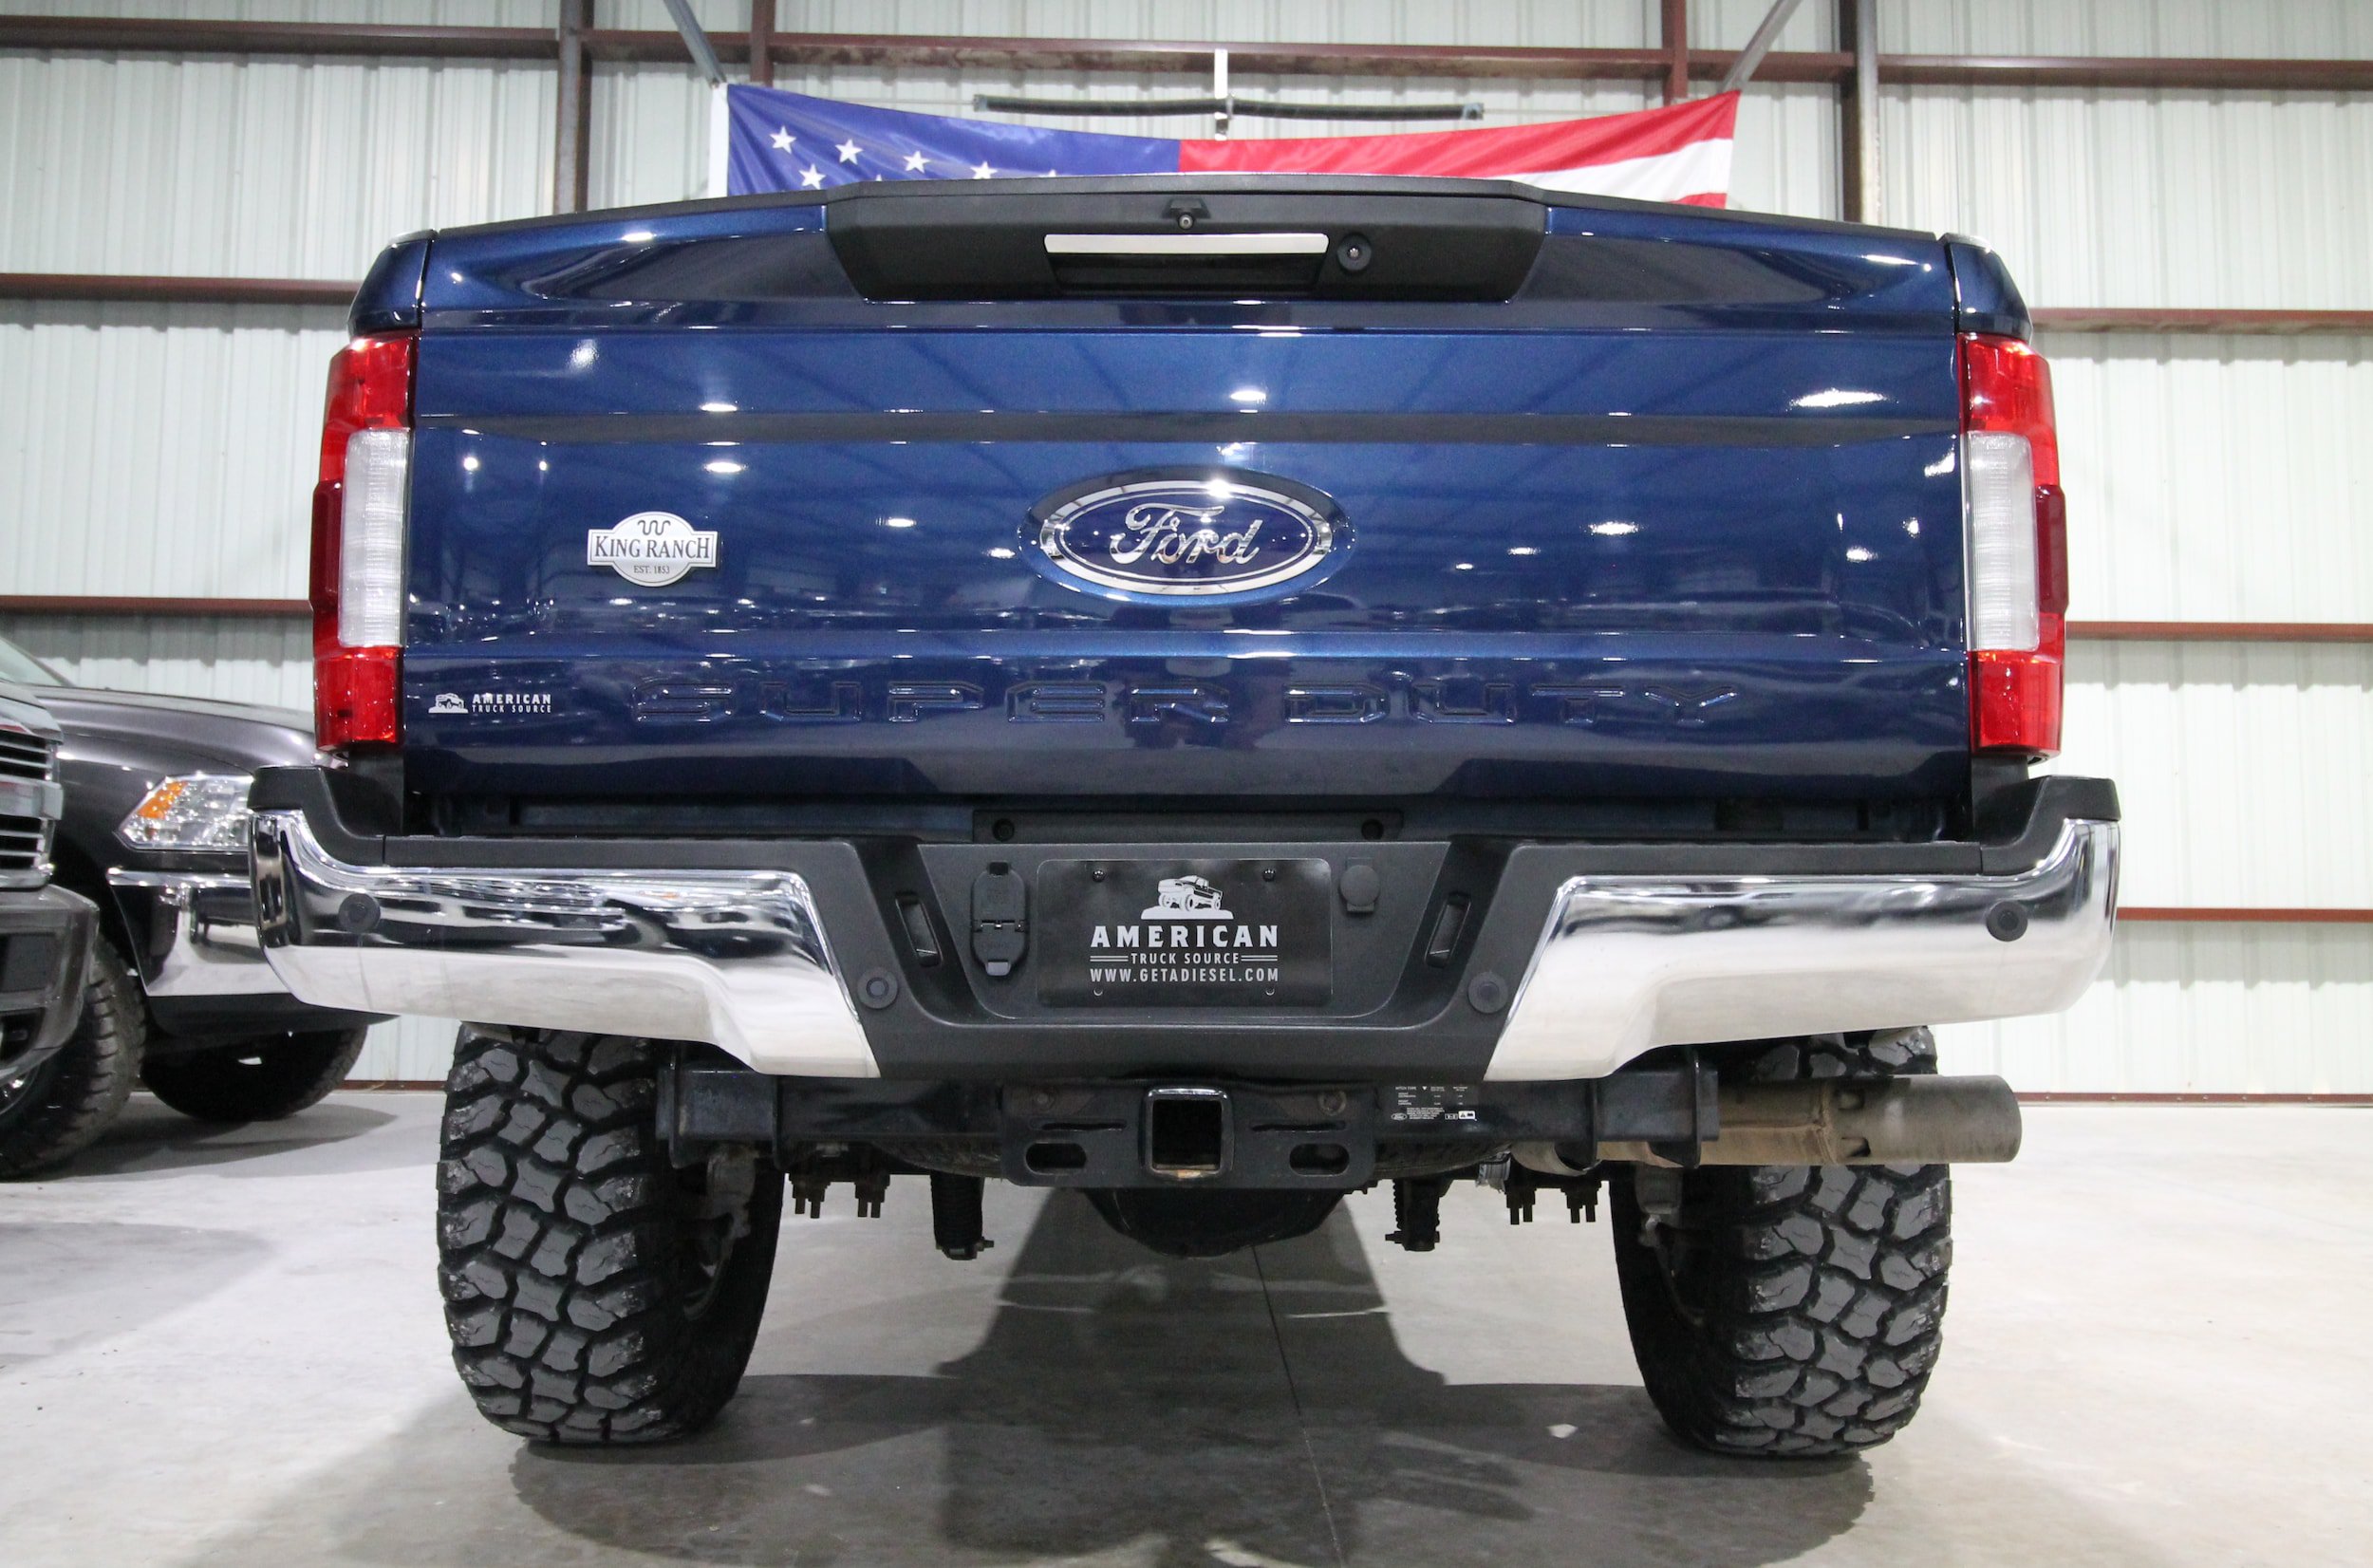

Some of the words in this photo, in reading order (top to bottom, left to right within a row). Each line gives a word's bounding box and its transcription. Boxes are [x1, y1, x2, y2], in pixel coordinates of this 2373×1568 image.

[1110, 502, 1262, 565] Ford
[594, 535, 641, 558] KING
[645, 537, 710, 559] RANCH
[633, 565, 652, 574] EST.
[654, 566, 670, 574] 1853
[472, 694, 551, 704] AMERICAN
[631, 680, 1229, 723] SUPER
[1283, 682, 1739, 724] DUTY
[472, 704, 505, 713] TRUCK
[1091, 924, 1278, 948] AMERICAN
[1130, 952, 1177, 964] TRUCK
[1184, 952, 1240, 964] SOURCE
[1090, 968, 1279, 982] WWW.GETADIESEL.COM
